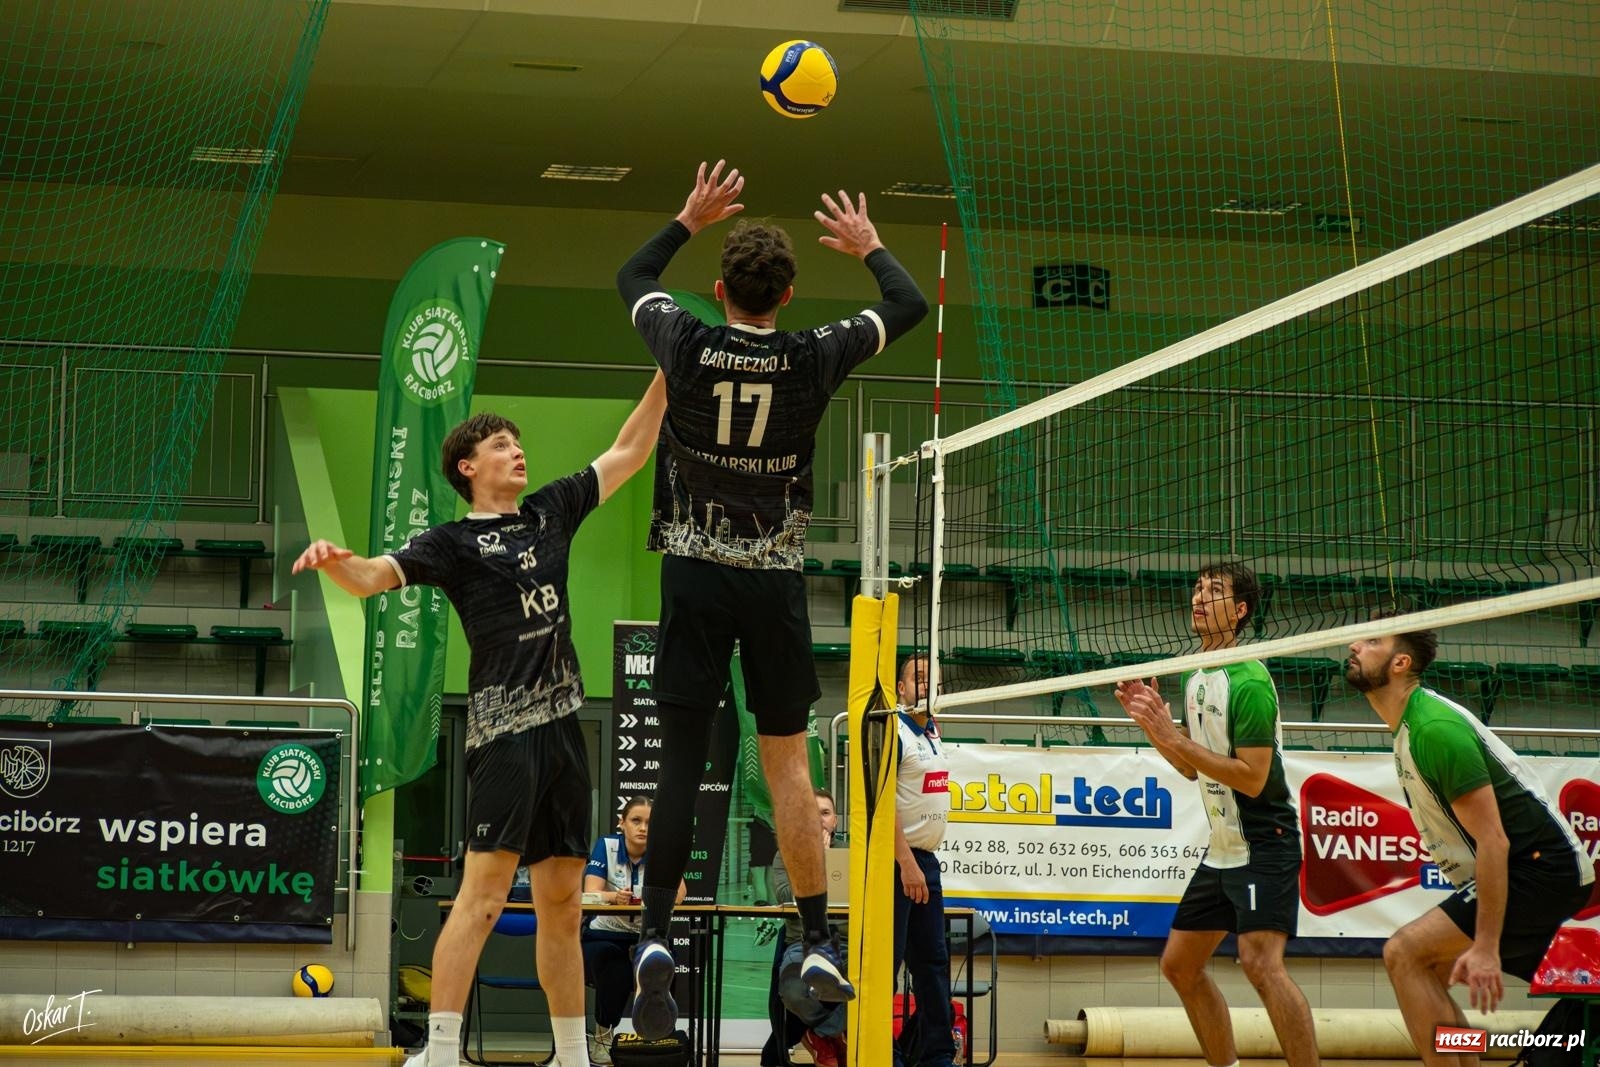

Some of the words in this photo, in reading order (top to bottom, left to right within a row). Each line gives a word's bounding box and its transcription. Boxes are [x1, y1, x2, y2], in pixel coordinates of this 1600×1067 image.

[402, 314, 424, 349] KLUB
[425, 306, 470, 361] SIATKARSKI
[700, 347, 778, 373] BARTECZKO
[780, 354, 792, 372] J.
[404, 373, 455, 400] RACIBÓRZ
[712, 381, 773, 448] 17
[686, 446, 761, 474] TKARSKI
[766, 454, 798, 474] KLUB
[520, 583, 559, 619] KB
[370, 630, 385, 707] KLUB
[262, 754, 280, 778] KLUB
[279, 748, 321, 780] SIATKARSKI
[620, 781, 658, 790] MINISIATK
[699, 781, 729, 792] OPCÓW
[947, 773, 1173, 818] nstal-tech
[268, 792, 315, 810] RACIBÓRZ
[1311, 805, 1379, 828] Radio
[98, 812, 267, 851] wspiera
[3, 840, 36, 857] 1217
[938, 840, 961, 853] 14
[964, 840, 982, 854] 92
[987, 839, 1010, 855] 88,
[1017, 841, 1044, 855] 502
[1049, 842, 1076, 856] 632
[1080, 844, 1111, 858] 695,
[1119, 844, 1147, 857] 606
[1150, 845, 1178, 859] 363
[1311, 833, 1434, 863] VANESS
[96, 857, 315, 903] siatkówkę
[952, 860, 1021, 877] Racibórz,
[1024, 862, 1042, 876] ul.
[1046, 863, 1057, 877] J.
[1061, 866, 1088, 877] von
[1092, 865, 1186, 880] Eichendorffa
[975, 907, 1130, 931] ww.instal-tech.pl
